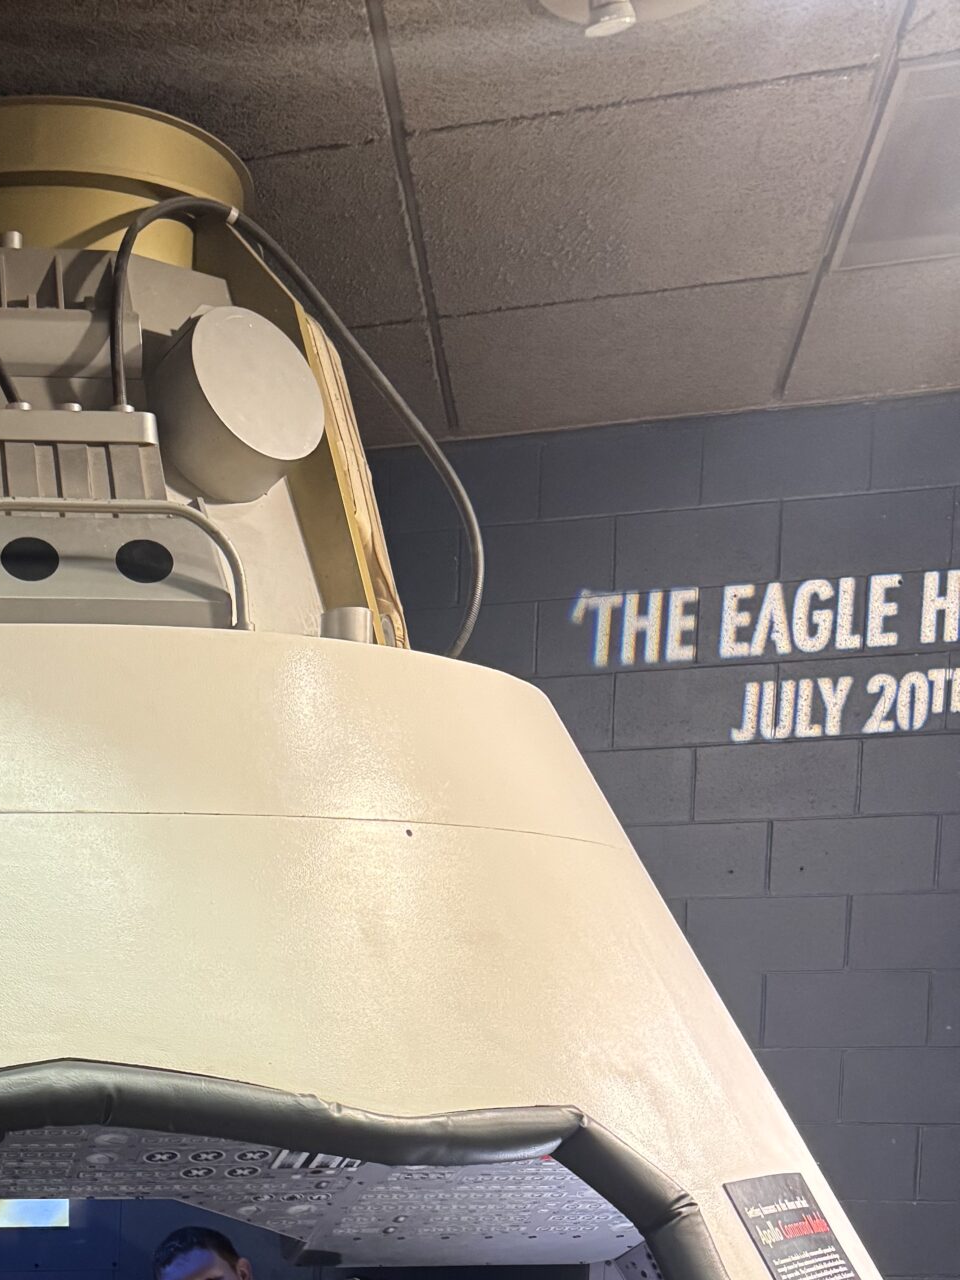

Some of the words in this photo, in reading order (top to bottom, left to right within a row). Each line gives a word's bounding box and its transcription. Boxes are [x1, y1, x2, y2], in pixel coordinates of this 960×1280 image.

[720, 573, 903, 659] EAGLE
[731, 676, 853, 743] JULY
[756, 1221, 784, 1248] Apollo
